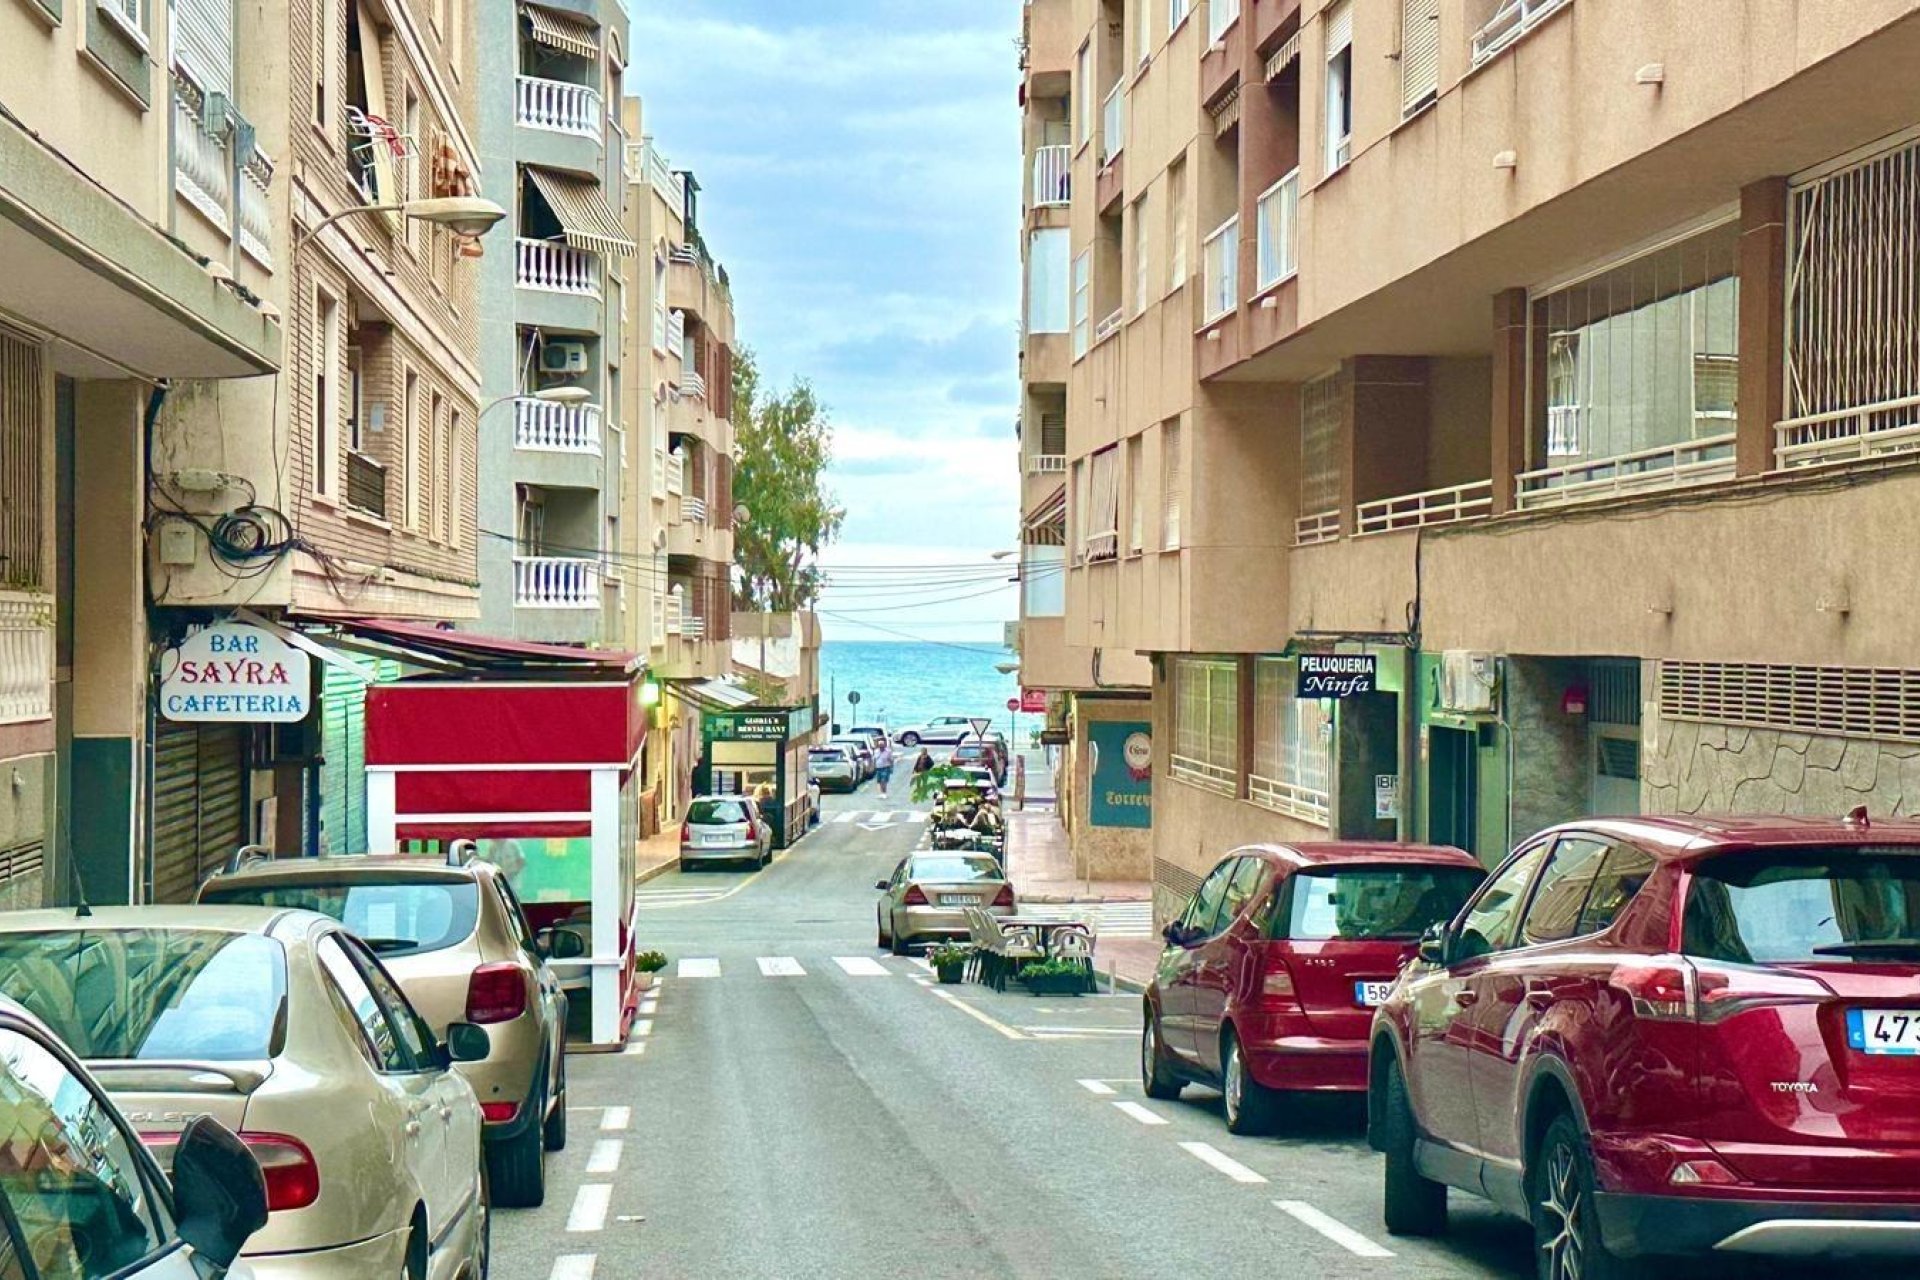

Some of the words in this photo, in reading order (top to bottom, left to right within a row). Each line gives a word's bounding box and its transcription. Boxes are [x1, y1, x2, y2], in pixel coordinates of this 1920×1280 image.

[210, 633, 258, 653] BAR
[180, 657, 290, 685] SAYRA
[1300, 656, 1374, 674] PELUQUERIA
[1303, 674, 1370, 697] Ninfa
[167, 695, 302, 713] CAFETERIA
[1770, 1081, 1818, 1093] TOYOTA
